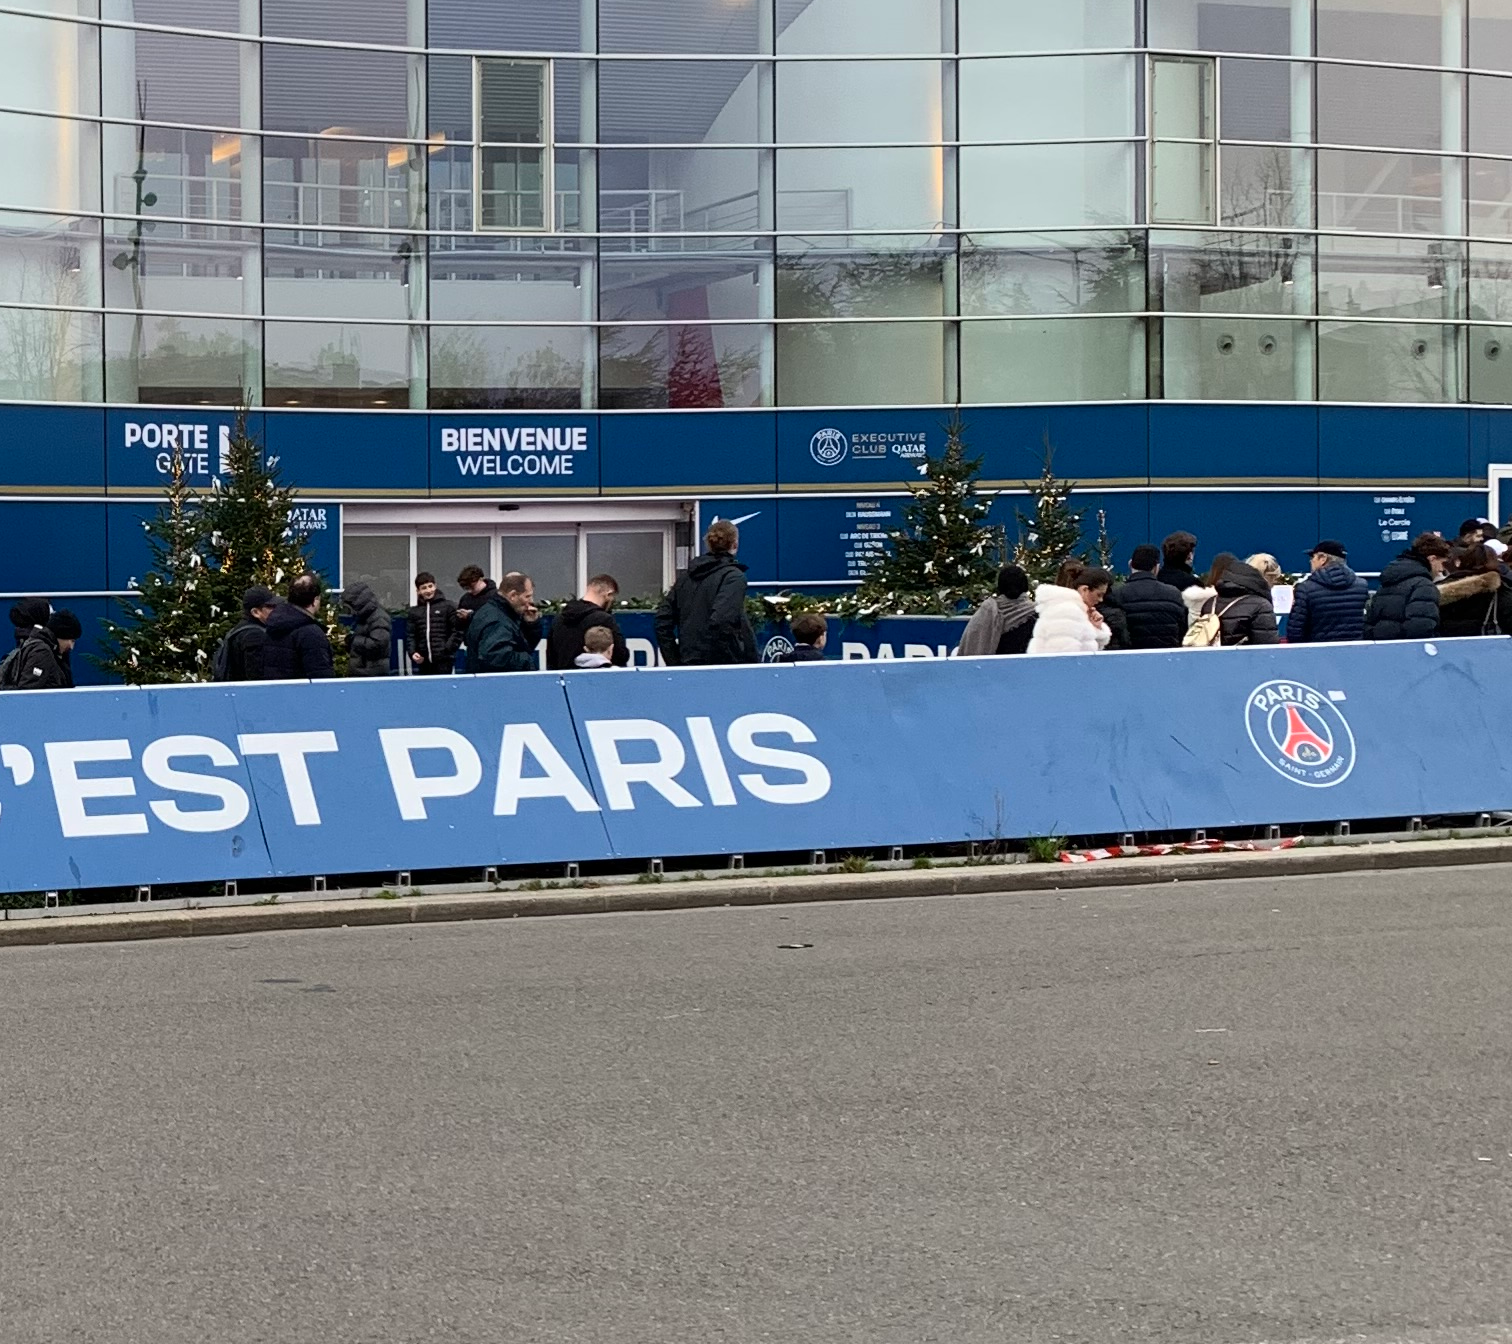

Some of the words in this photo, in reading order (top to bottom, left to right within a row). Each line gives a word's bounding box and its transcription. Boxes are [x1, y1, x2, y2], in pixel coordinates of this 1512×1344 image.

[124, 423, 209, 449] PORTE
[441, 427, 587, 452] BIENVENUE
[851, 433, 926, 443] EXECUTIVE
[851, 444, 887, 454] CLUB
[891, 444, 926, 456] QATAR
[456, 454, 574, 475] WELCOME
[1254, 685, 1320, 712] PARIS
[378, 712, 832, 821] PARIS
